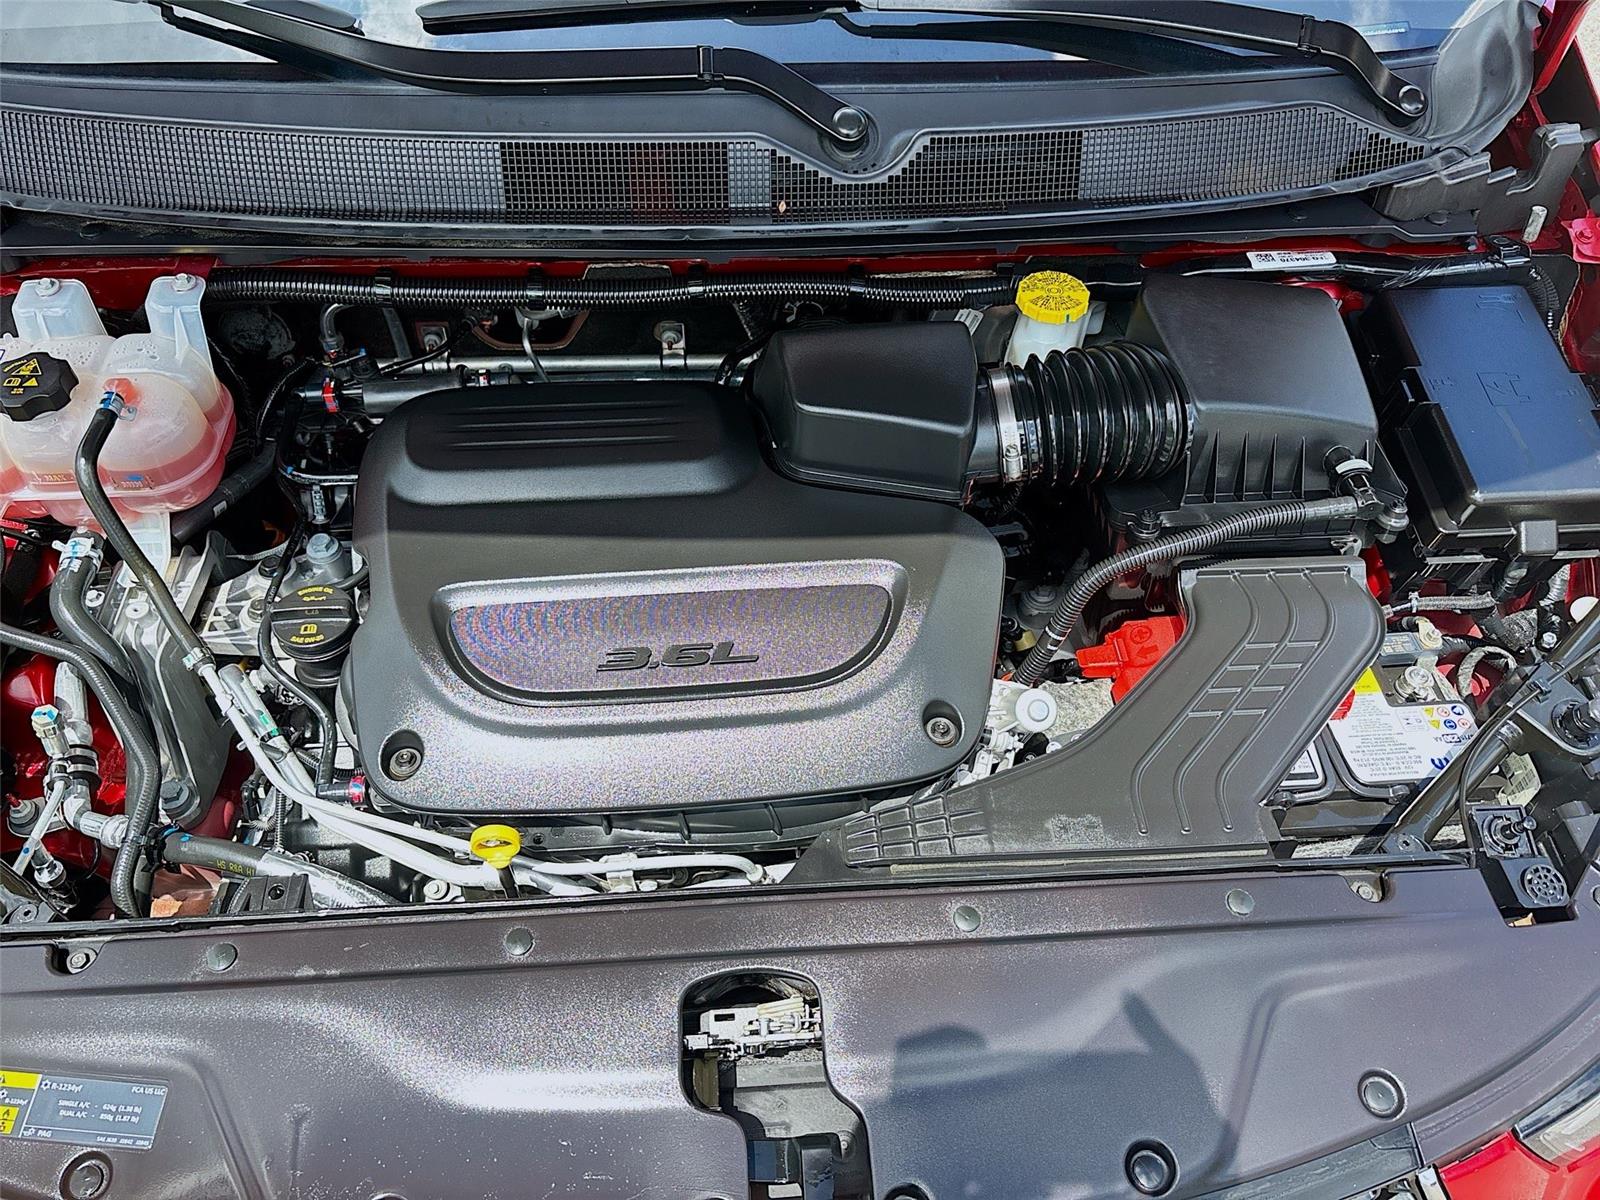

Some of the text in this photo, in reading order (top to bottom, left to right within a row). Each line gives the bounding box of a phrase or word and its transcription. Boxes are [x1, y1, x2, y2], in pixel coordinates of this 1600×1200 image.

[297, 586, 323, 596] ENGINE
[596, 640, 760, 672] 3.6L
[51, 1082, 83, 1093] R-1234yf
[131, 1086, 166, 1096] FCA US LLC
[58, 1099, 79, 1108] SINGLE
[78, 1101, 91, 1109] A/C
[59, 1109, 76, 1117] DUAL
[75, 1111, 88, 1119] A/C
[37, 1130, 53, 1138] PAG
